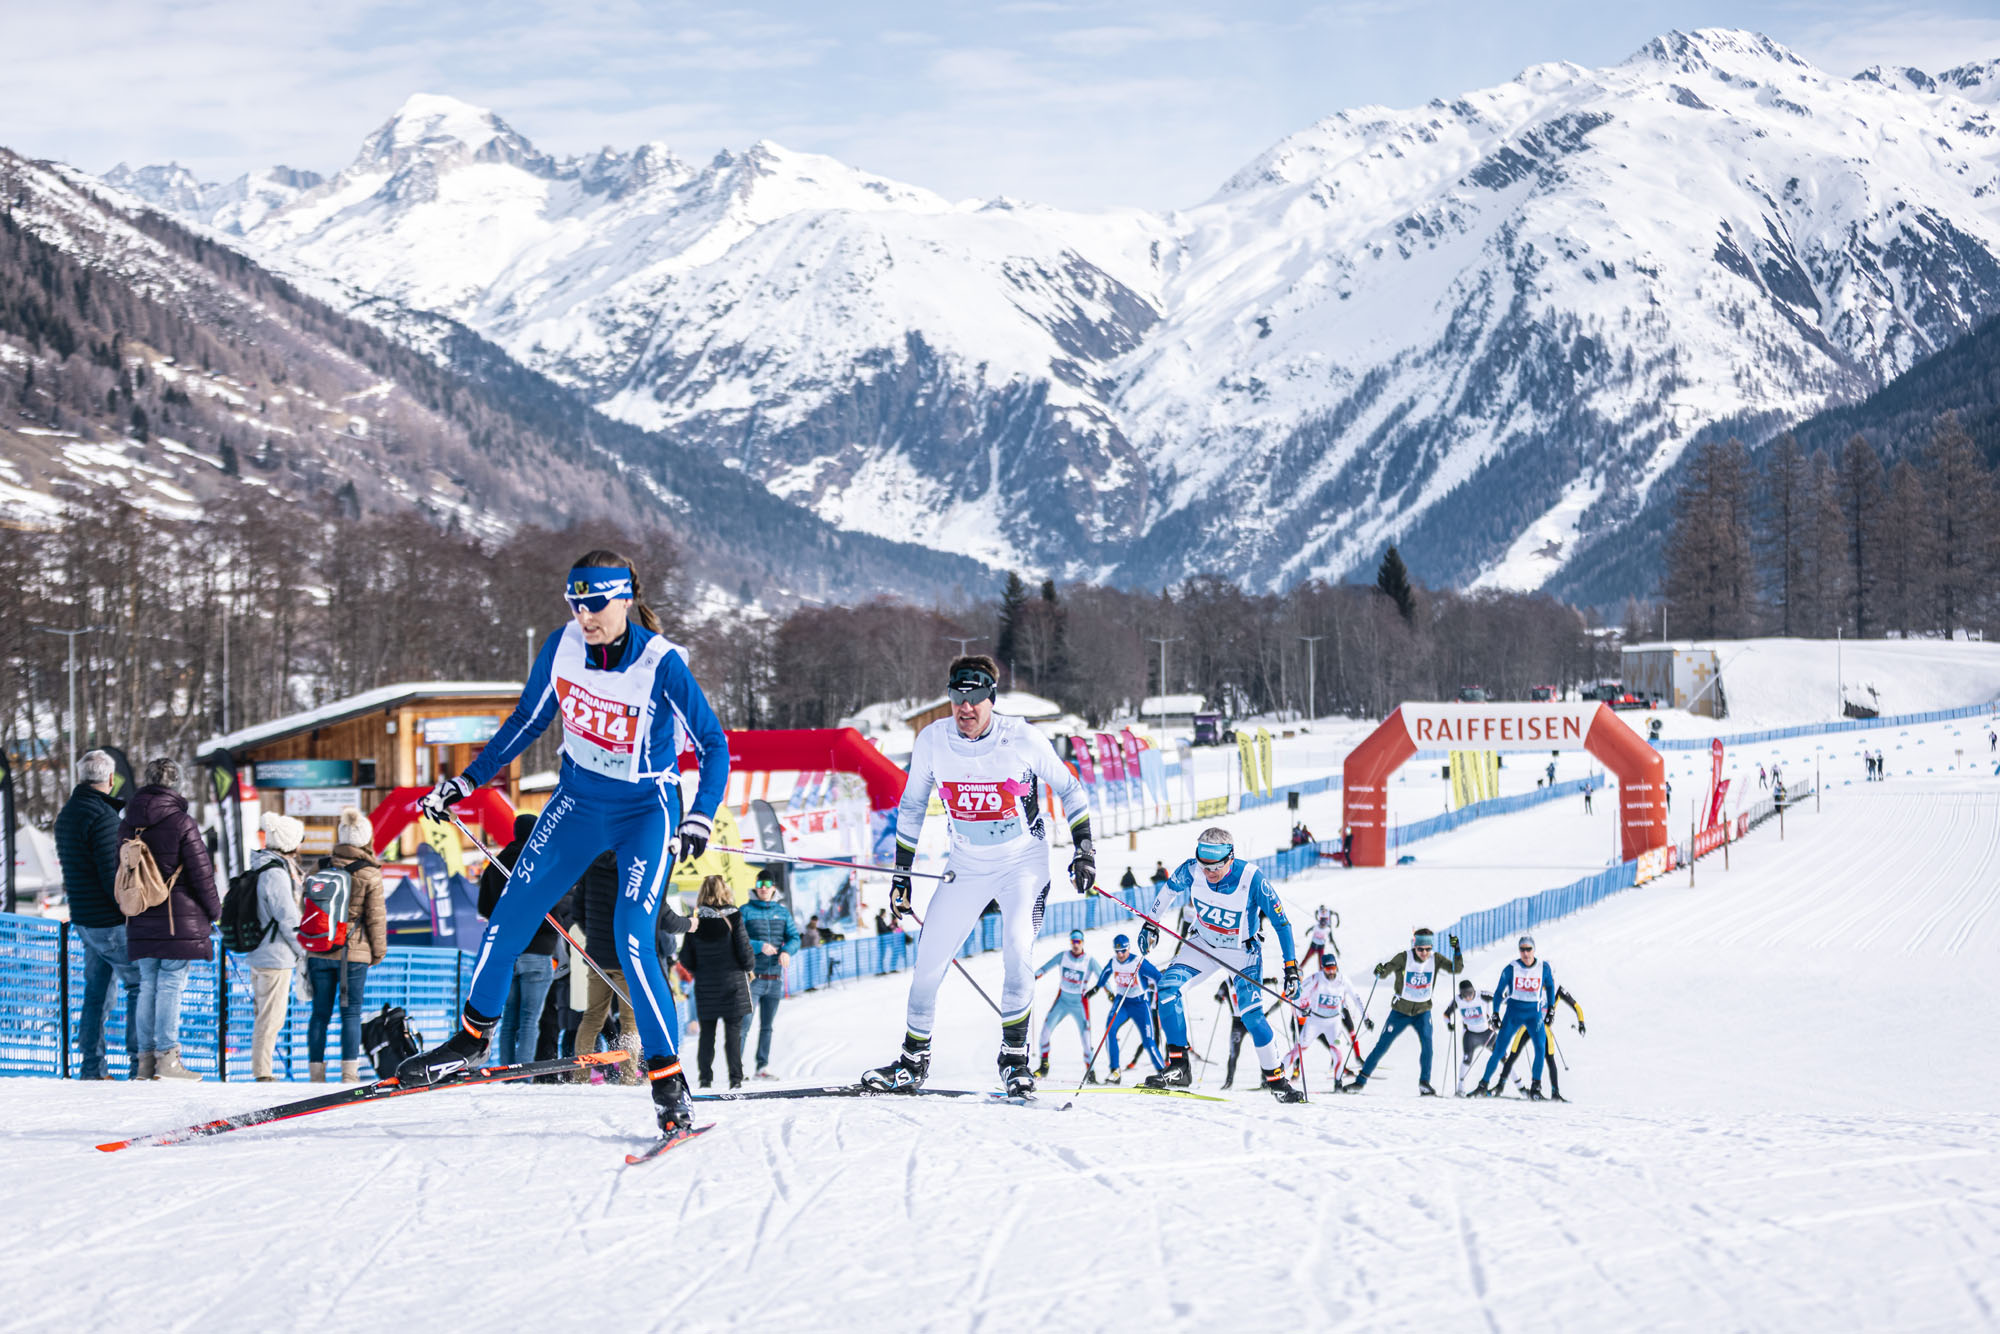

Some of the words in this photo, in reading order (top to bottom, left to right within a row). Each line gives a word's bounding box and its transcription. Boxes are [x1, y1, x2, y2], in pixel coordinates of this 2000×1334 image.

[568, 684, 624, 716] MARIANNE
[628, 706, 638, 716] B
[560, 696, 628, 741] 4214
[1416, 716, 1581, 741] RAIFFEISEN
[957, 784, 998, 792] DOMINIK
[957, 792, 1003, 811] 479
[517, 857, 534, 884] SC
[529, 794, 576, 856] Rüschegg
[1196, 901, 1237, 928] 745
[1410, 976, 1428, 986] 678
[1516, 978, 1539, 990] 506
[1320, 994, 1341, 1005] 739
